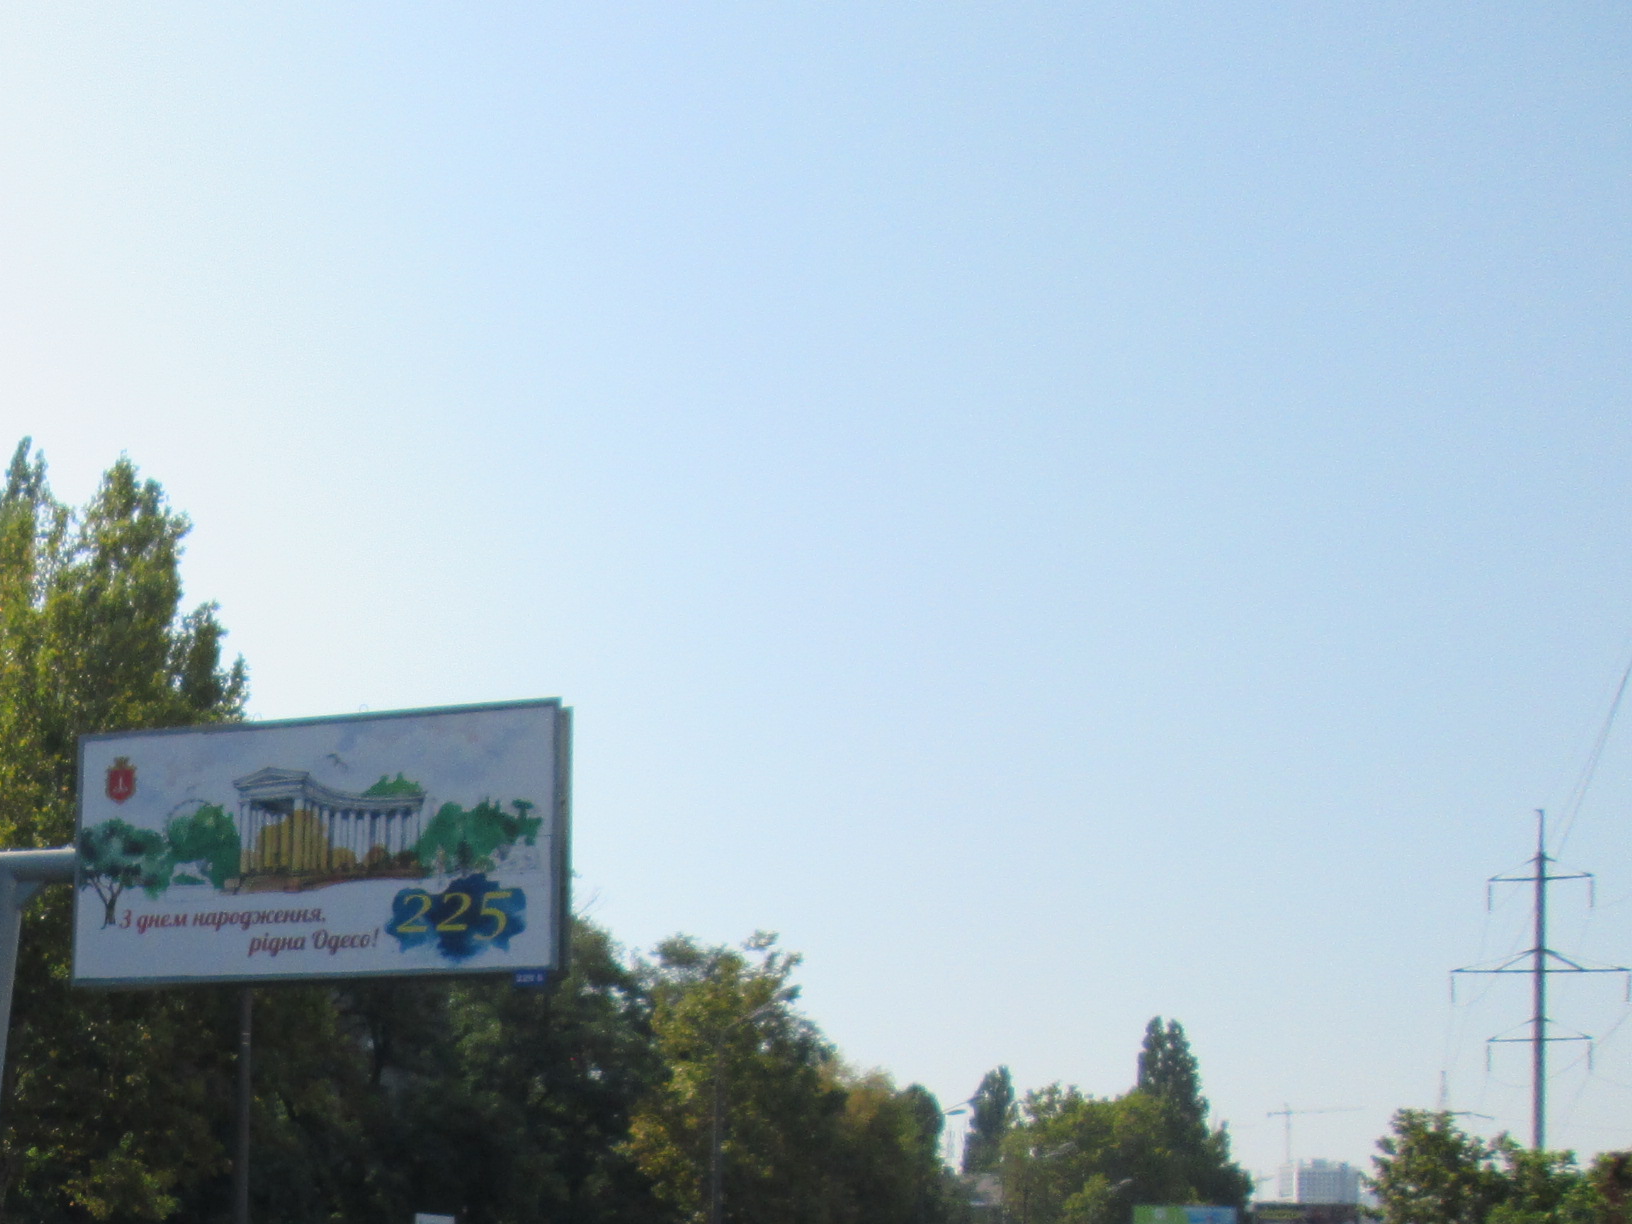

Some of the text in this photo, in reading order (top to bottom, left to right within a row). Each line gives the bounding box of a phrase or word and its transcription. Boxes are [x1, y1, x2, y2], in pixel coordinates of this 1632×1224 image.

[137, 913, 187, 934] днем
[396, 890, 513, 940] 225
[247, 928, 379, 958] рідна Одесо!
